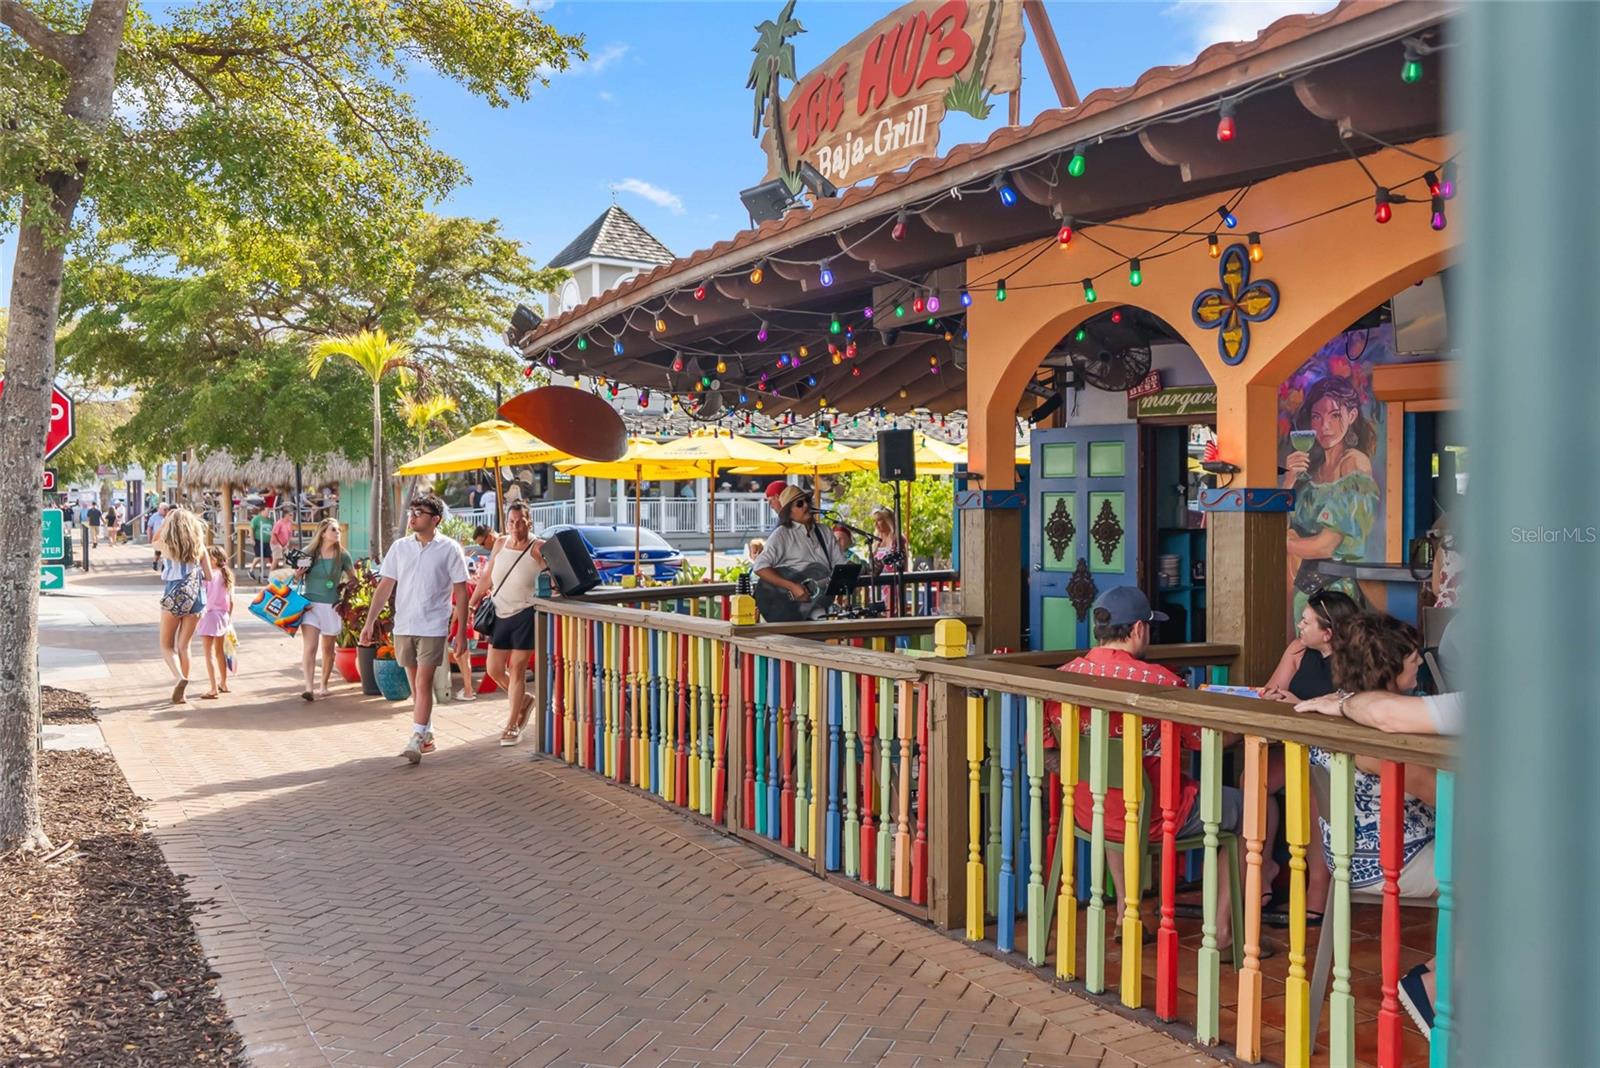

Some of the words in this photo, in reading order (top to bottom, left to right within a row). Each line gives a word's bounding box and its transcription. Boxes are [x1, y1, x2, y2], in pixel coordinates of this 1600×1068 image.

[788, 62, 848, 154] THE
[857, 0, 974, 116] HUB
[816, 104, 928, 178] Baja-Grill
[1141, 392, 1217, 414] margari
